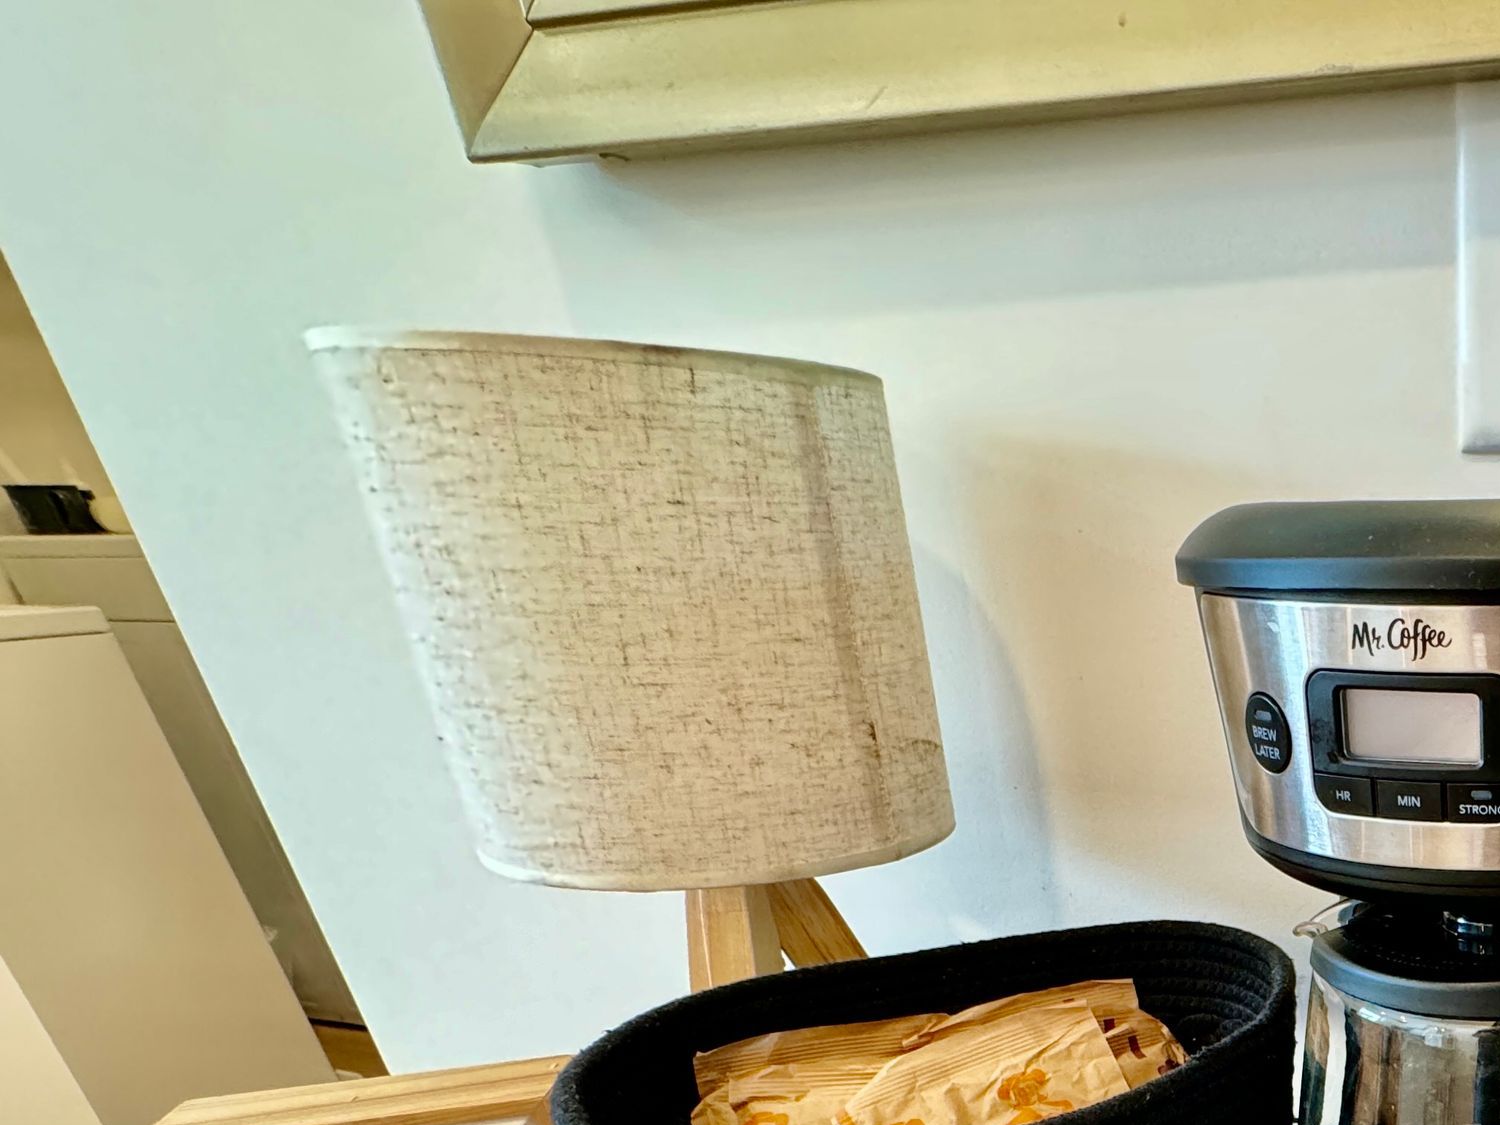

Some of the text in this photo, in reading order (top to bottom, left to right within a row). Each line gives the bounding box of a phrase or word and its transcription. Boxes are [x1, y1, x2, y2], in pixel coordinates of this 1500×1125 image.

[1351, 617, 1453, 662] Mr. Coffee
[1251, 725, 1277, 742] BREW
[1254, 743, 1281, 760] LATER
[1335, 789, 1351, 801] HR
[1397, 795, 1421, 808] MIN
